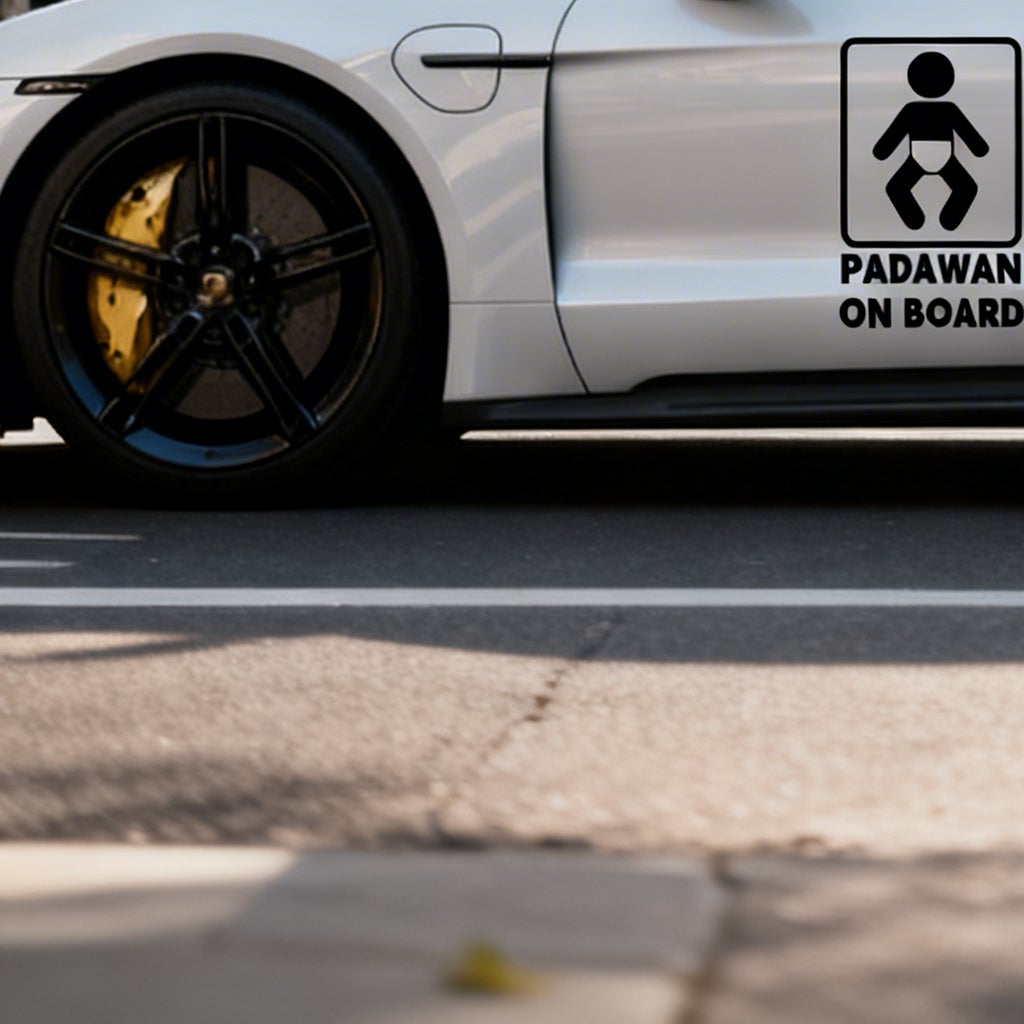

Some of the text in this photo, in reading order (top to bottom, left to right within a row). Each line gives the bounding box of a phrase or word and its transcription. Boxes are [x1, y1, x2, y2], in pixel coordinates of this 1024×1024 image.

[840, 253, 1022, 285] PADAWAN
[838, 297, 1024, 329] ON BOARD
